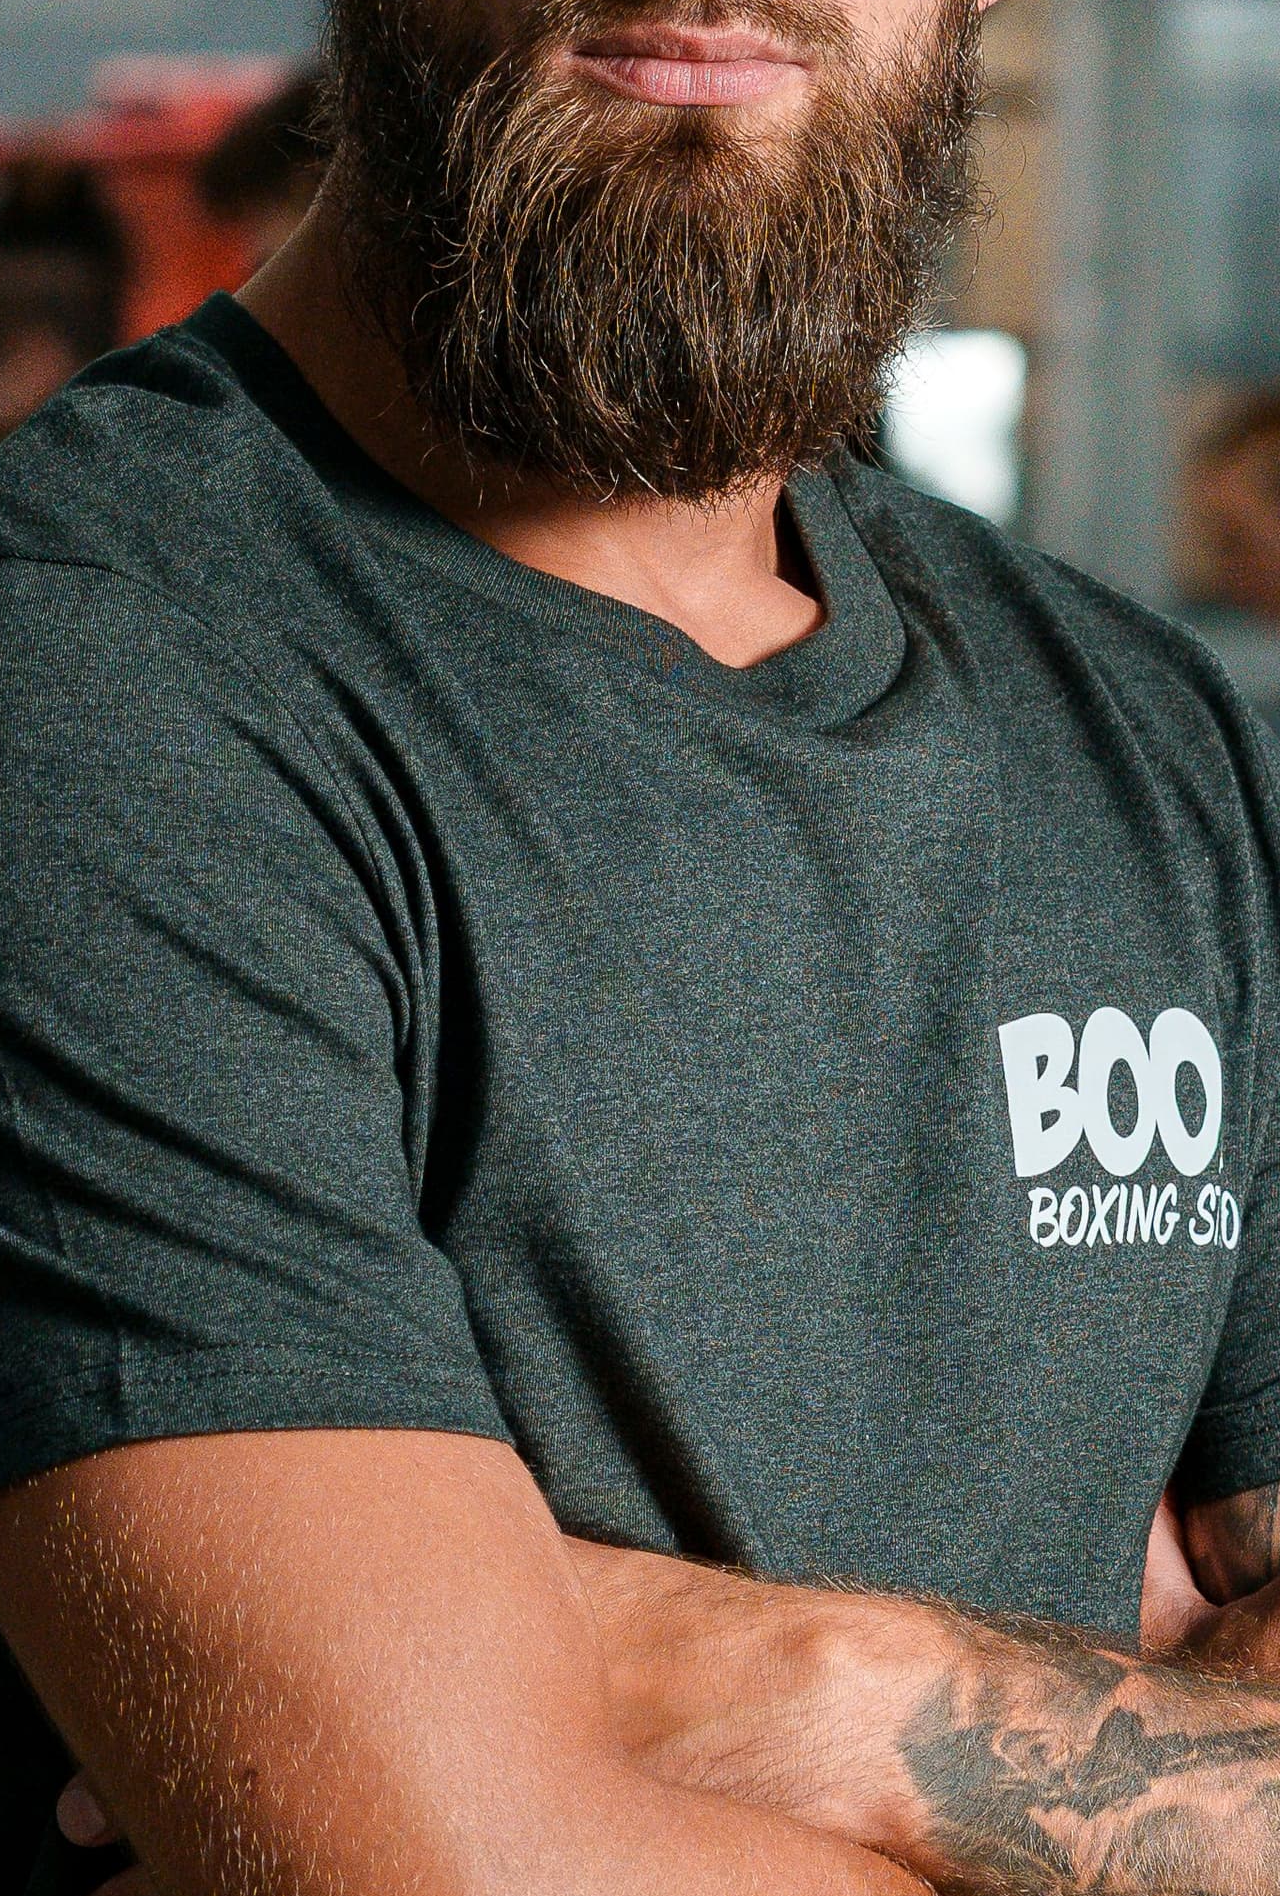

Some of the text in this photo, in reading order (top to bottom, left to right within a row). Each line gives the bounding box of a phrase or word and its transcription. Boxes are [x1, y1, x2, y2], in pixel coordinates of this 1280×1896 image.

[998, 1006, 1223, 1177] BOO
[1028, 1183, 1240, 1250] BOXING SO
